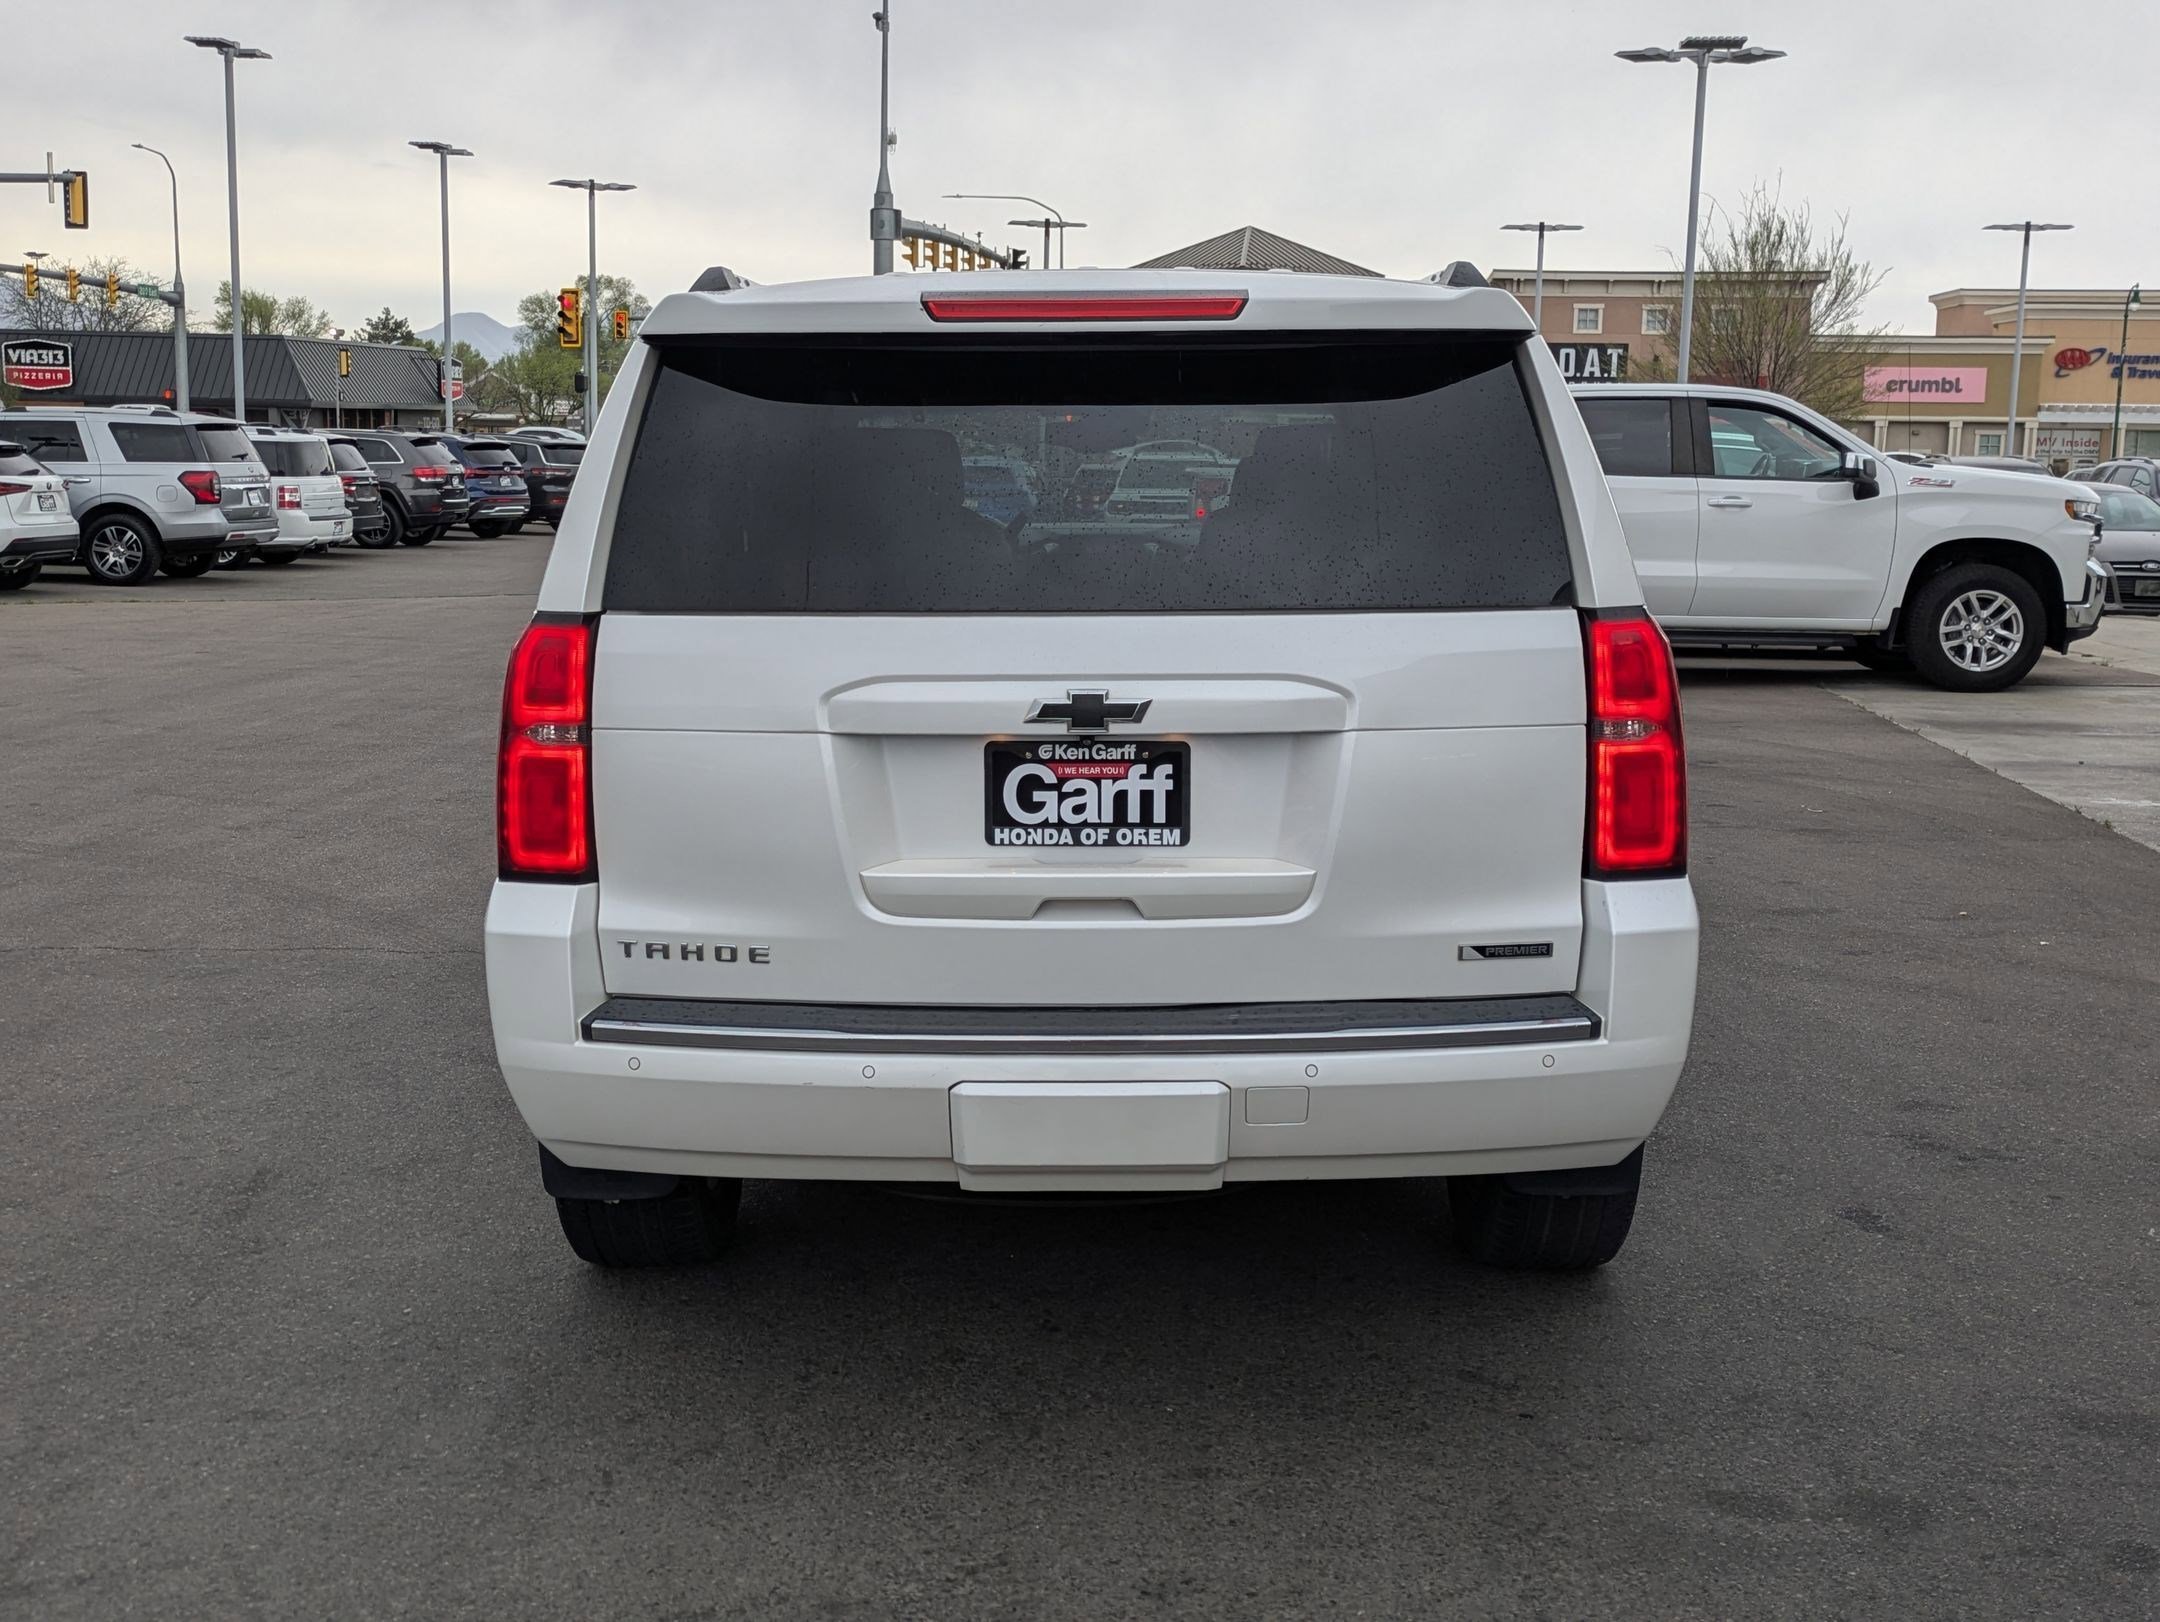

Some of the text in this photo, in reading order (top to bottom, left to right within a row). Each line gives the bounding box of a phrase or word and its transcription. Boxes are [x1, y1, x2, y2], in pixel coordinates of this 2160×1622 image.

[13, 372, 63, 380] PIZZERIA
[2062, 437, 2099, 447] Inside
[1054, 744, 1137, 760] Ken Garff
[1003, 763, 1174, 825] Garff
[994, 828, 1181, 845] HONDA OF OREM
[617, 939, 770, 964] TAHOE
[1485, 945, 1548, 956] PREMIER
